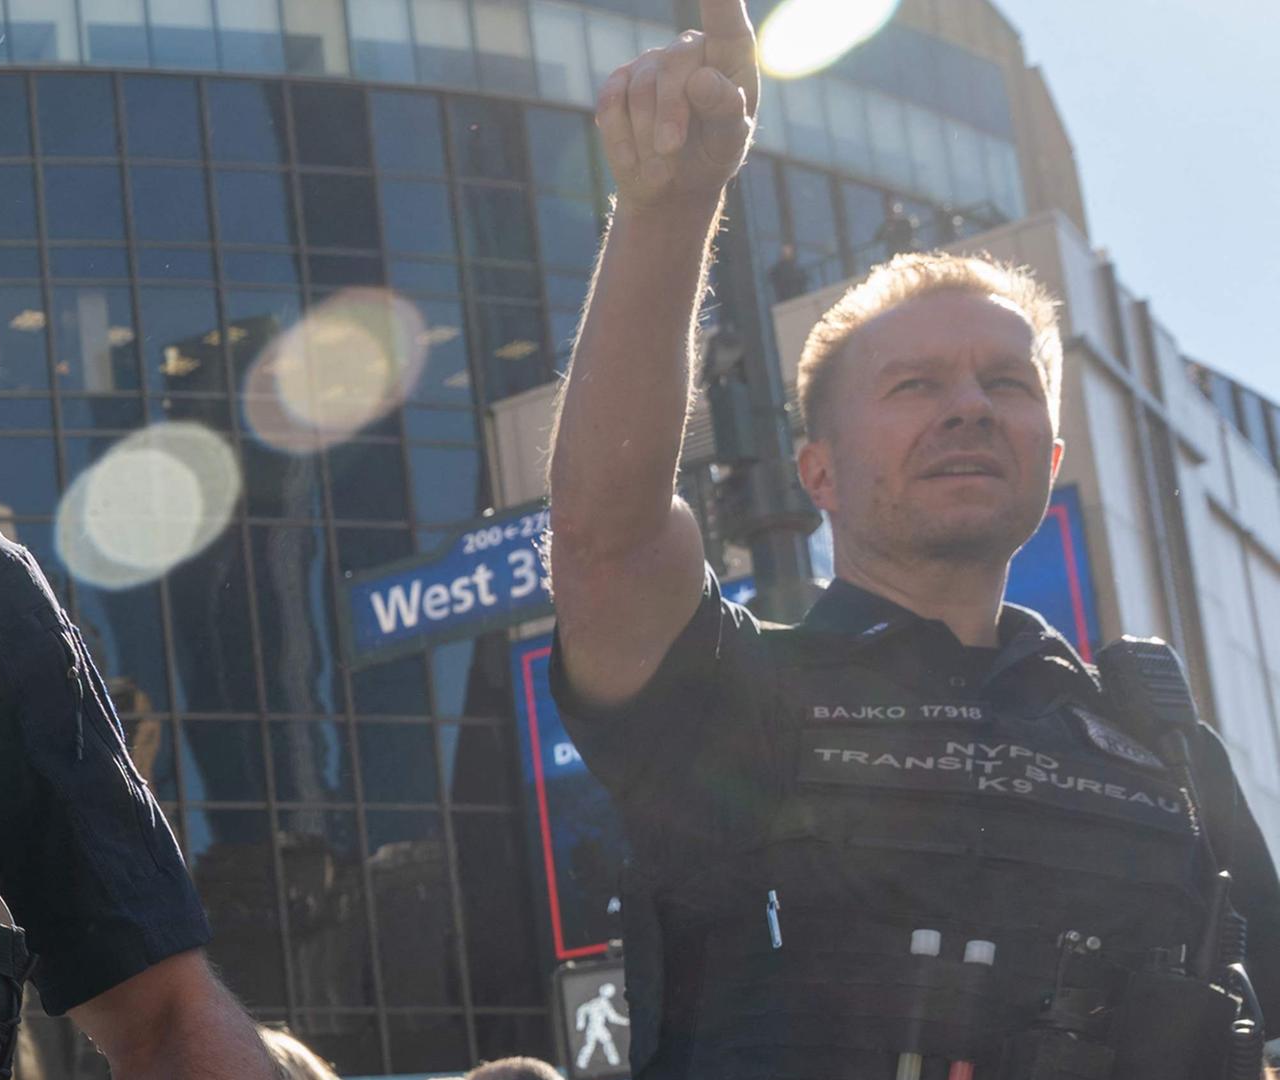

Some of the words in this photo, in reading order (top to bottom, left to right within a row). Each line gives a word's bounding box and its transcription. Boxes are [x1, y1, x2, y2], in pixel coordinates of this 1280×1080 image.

[462, 525, 504, 554] 200
[370, 562, 497, 634] West
[507, 549, 539, 598] 3
[813, 706, 906, 719] BAJKO
[920, 705, 982, 720] 17918
[946, 741, 1059, 770] NYPD
[814, 749, 1002, 773] TRANSIT
[1025, 765, 1180, 814] BUREAU
[978, 775, 1033, 793] K9
